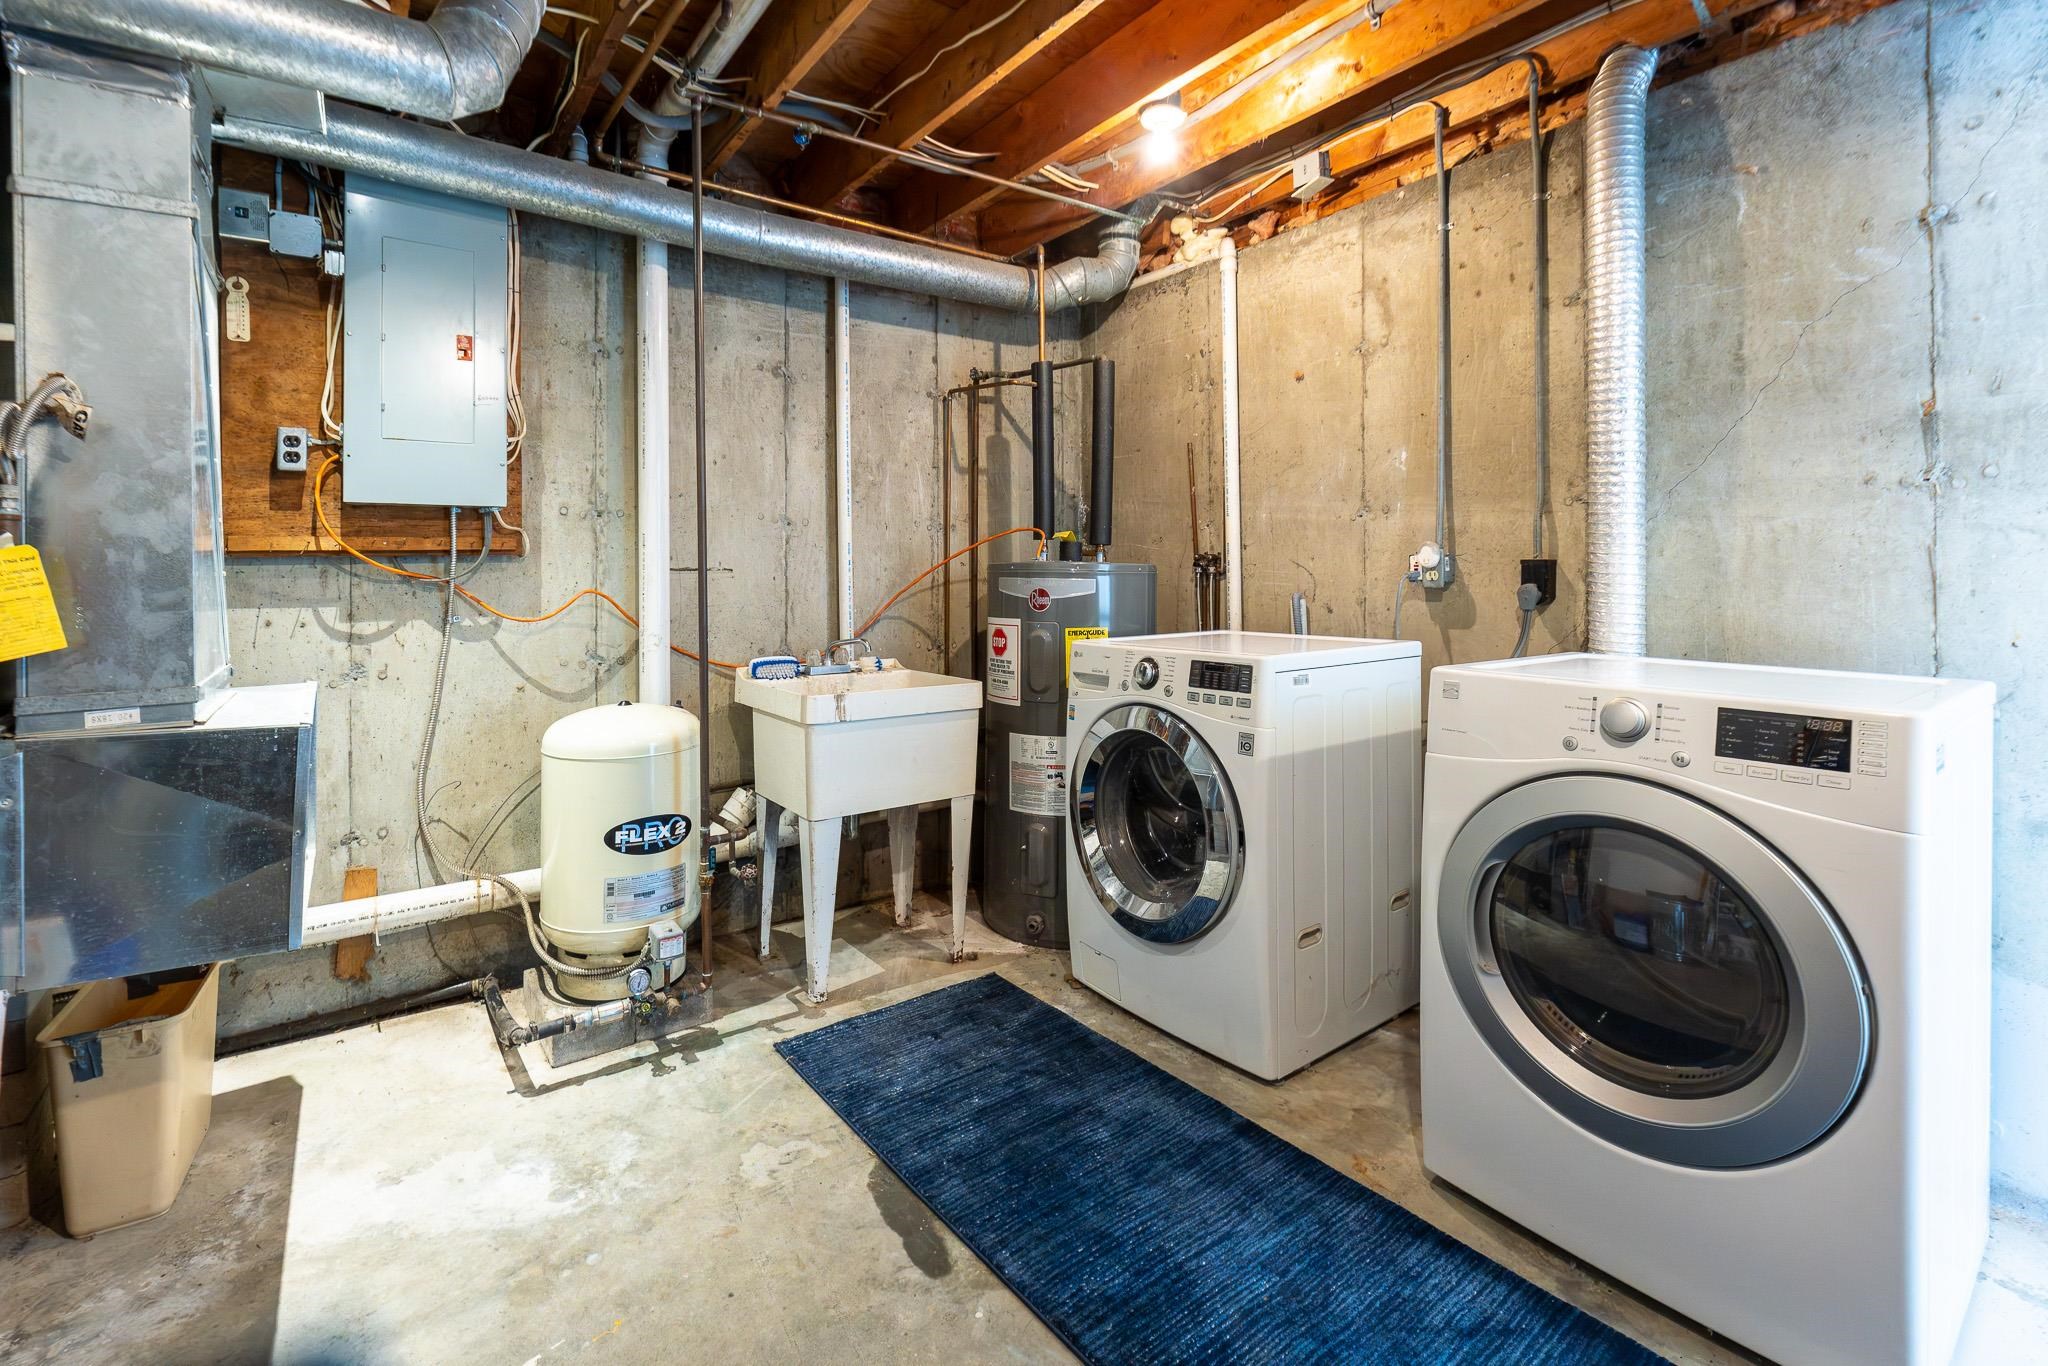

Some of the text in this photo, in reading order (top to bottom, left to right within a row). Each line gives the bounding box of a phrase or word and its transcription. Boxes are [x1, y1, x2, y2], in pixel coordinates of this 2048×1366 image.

[1032, 588, 1049, 608] Rheem
[1068, 629, 1105, 638] ENERGYGUIDE
[993, 637, 1005, 648] STOP
[615, 820, 686, 844] FLEX 2
